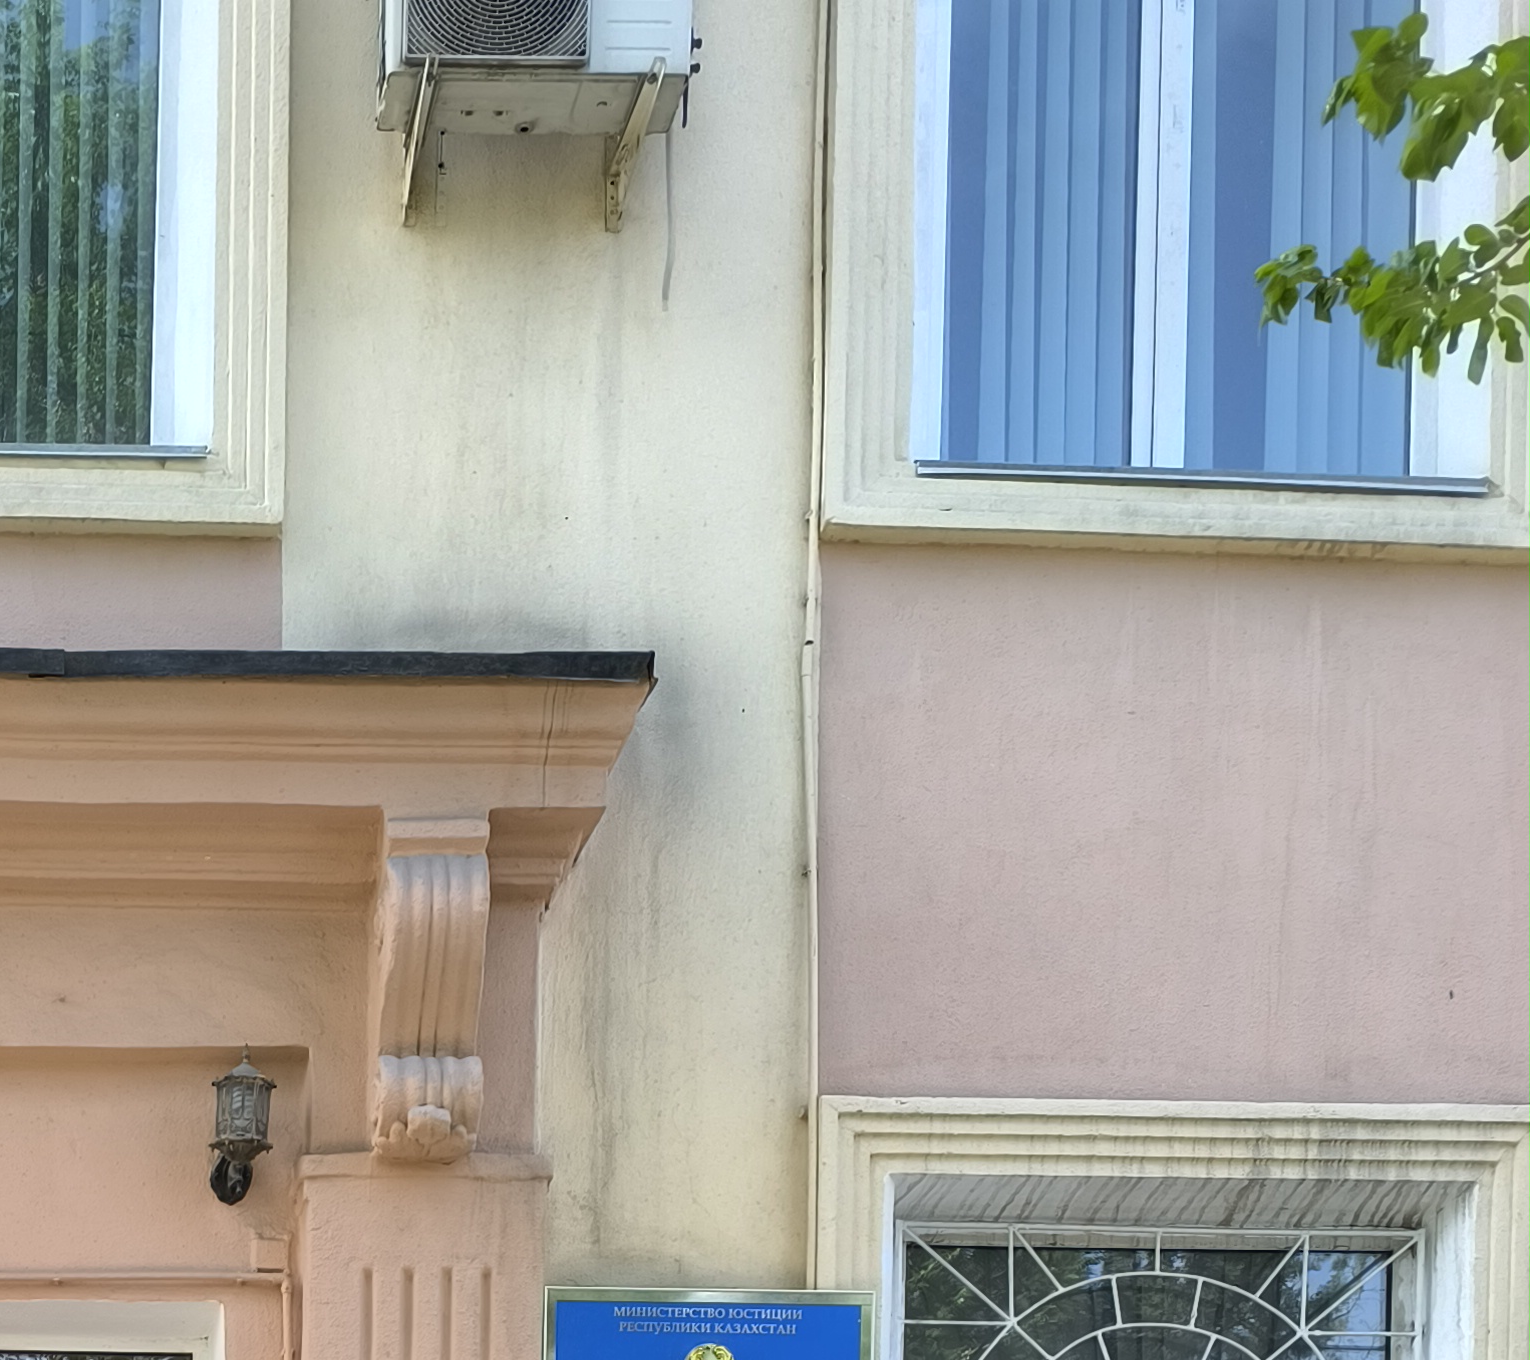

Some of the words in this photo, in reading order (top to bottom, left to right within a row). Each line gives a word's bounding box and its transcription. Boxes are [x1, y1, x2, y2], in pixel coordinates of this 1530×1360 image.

[614, 1306, 725, 1319] МИНИСТЕРСТВО
[728, 1308, 803, 1321] ЮСТИЦИИ
[619, 1321, 713, 1336] РЕСПУБЛИКИ
[714, 1322, 797, 1335] КАЗАХСТАН
